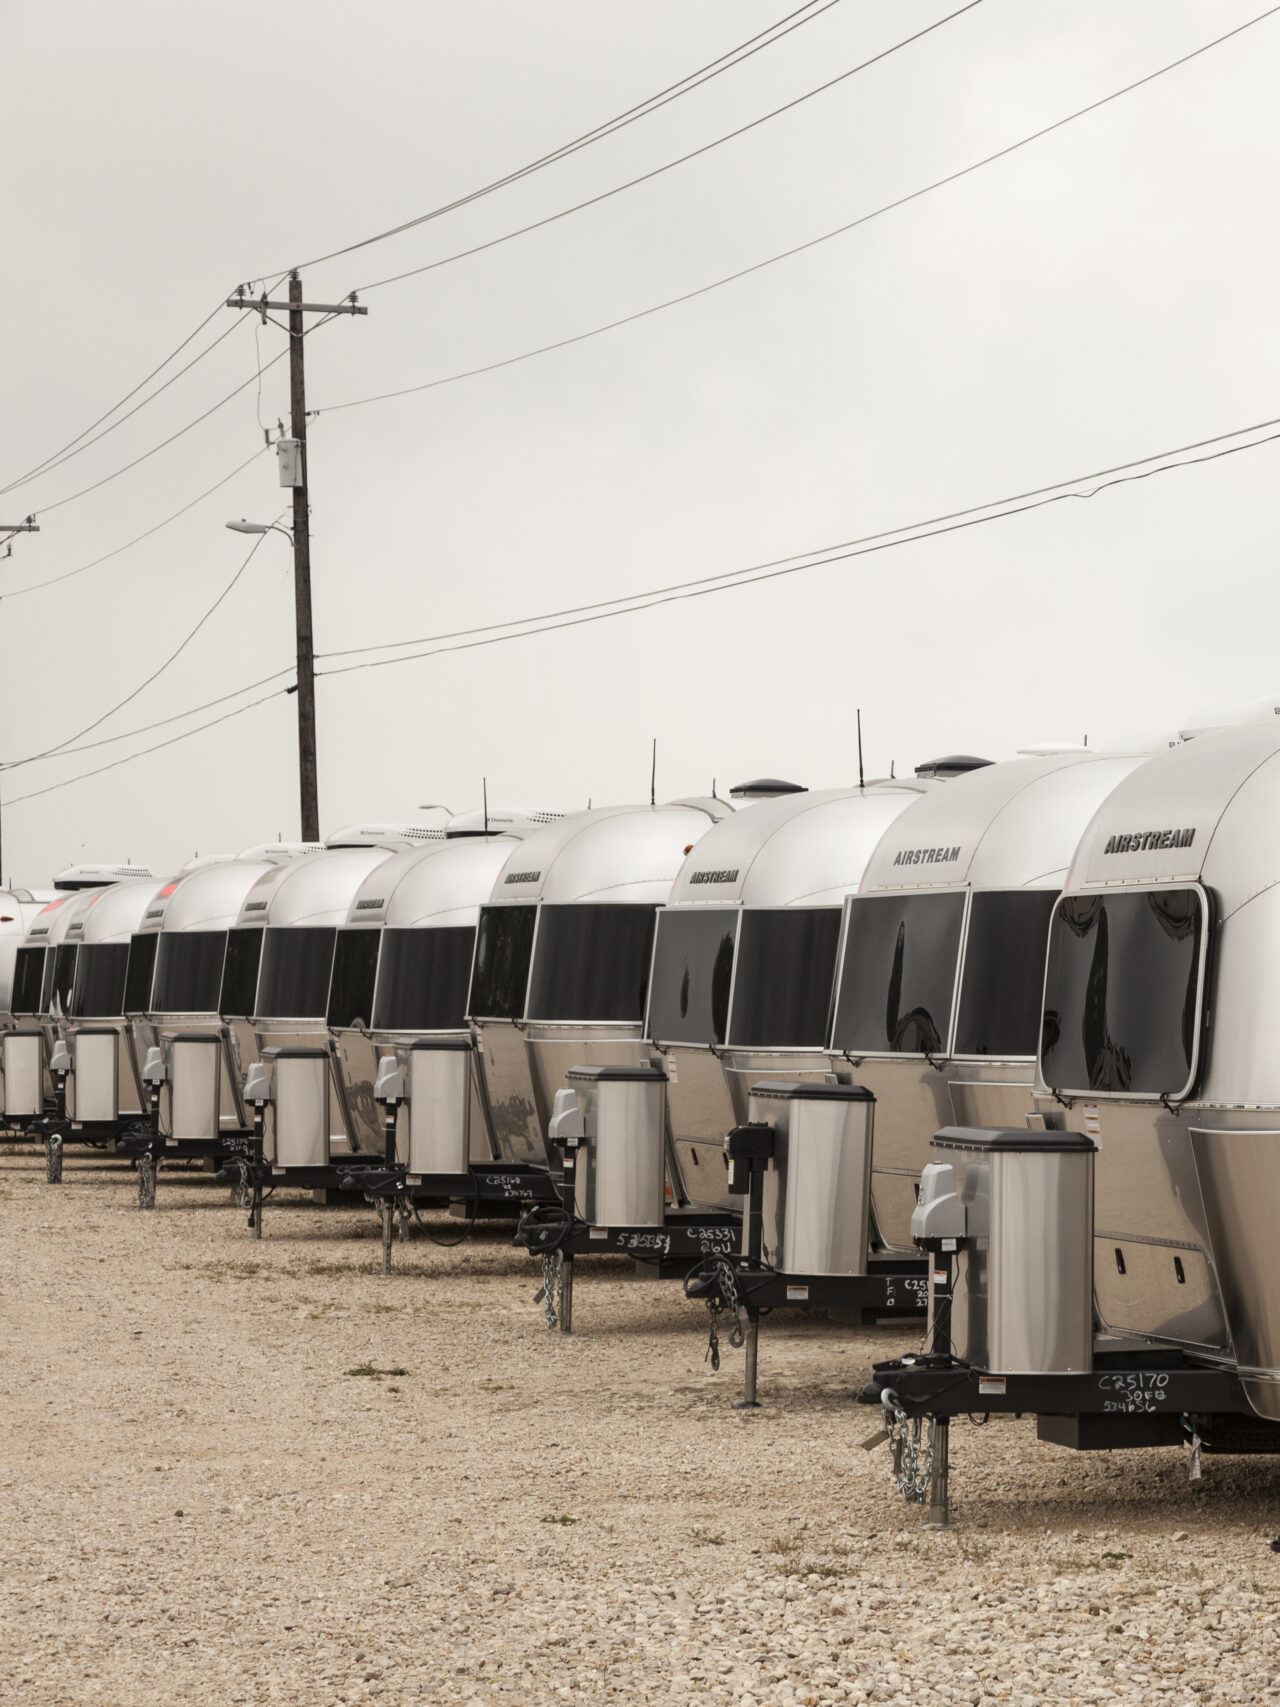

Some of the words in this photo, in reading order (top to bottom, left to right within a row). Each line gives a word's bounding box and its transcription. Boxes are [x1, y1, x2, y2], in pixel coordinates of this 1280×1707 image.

[1104, 828, 1196, 854] AIRSTREAM
[893, 846, 961, 866] AIRSTREAM
[689, 869, 739, 884] AIRSTREAM
[1098, 1373, 1169, 1390] C25170
